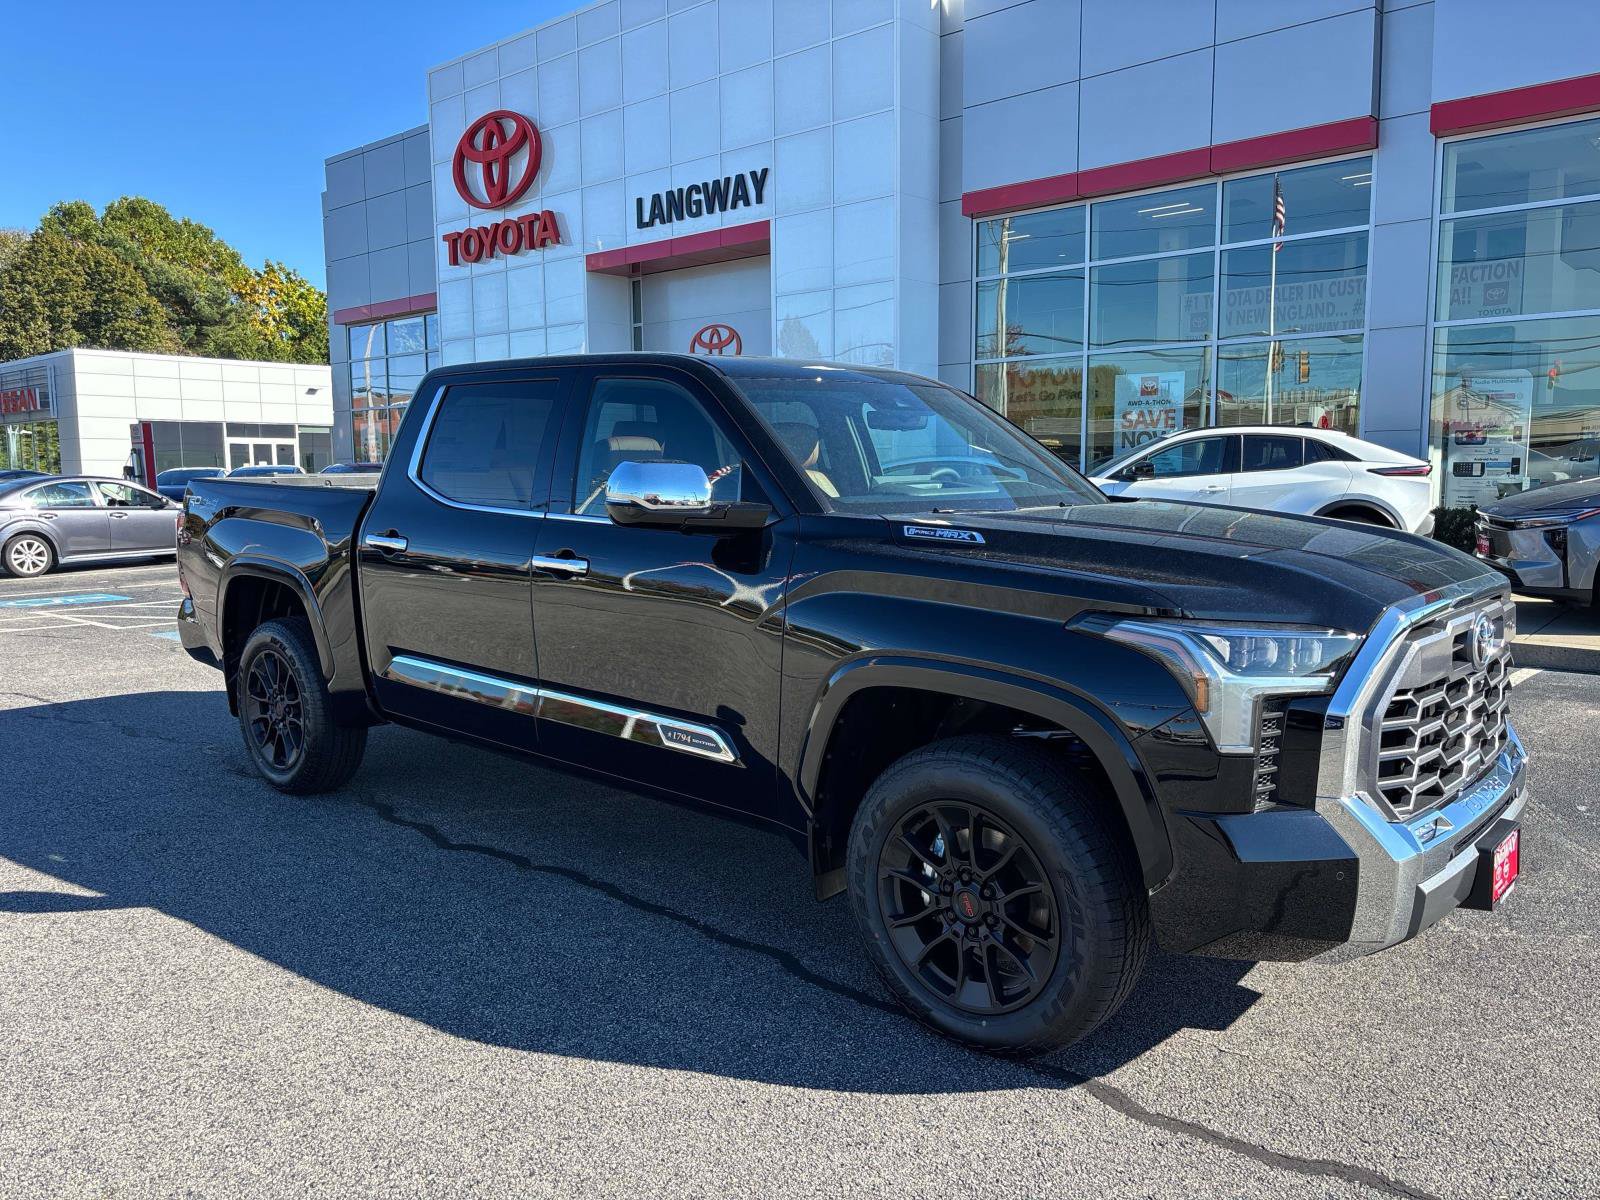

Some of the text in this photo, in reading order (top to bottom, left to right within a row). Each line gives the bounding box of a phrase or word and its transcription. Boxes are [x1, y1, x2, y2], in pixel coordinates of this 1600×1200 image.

[636, 168, 769, 228] LANGWAY
[443, 210, 561, 266] TOYOTA
[1451, 261, 1520, 284] FACTION
[1308, 283, 1324, 301] IN
[1236, 308, 1265, 325] NEW
[1478, 307, 1512, 317] TOYOTA
[1038, 390, 1056, 401] Go
[1121, 408, 1176, 429] SAVE
[935, 528, 971, 540] MAX
[673, 731, 691, 743] 1794
[962, 895, 974, 917] TRD
